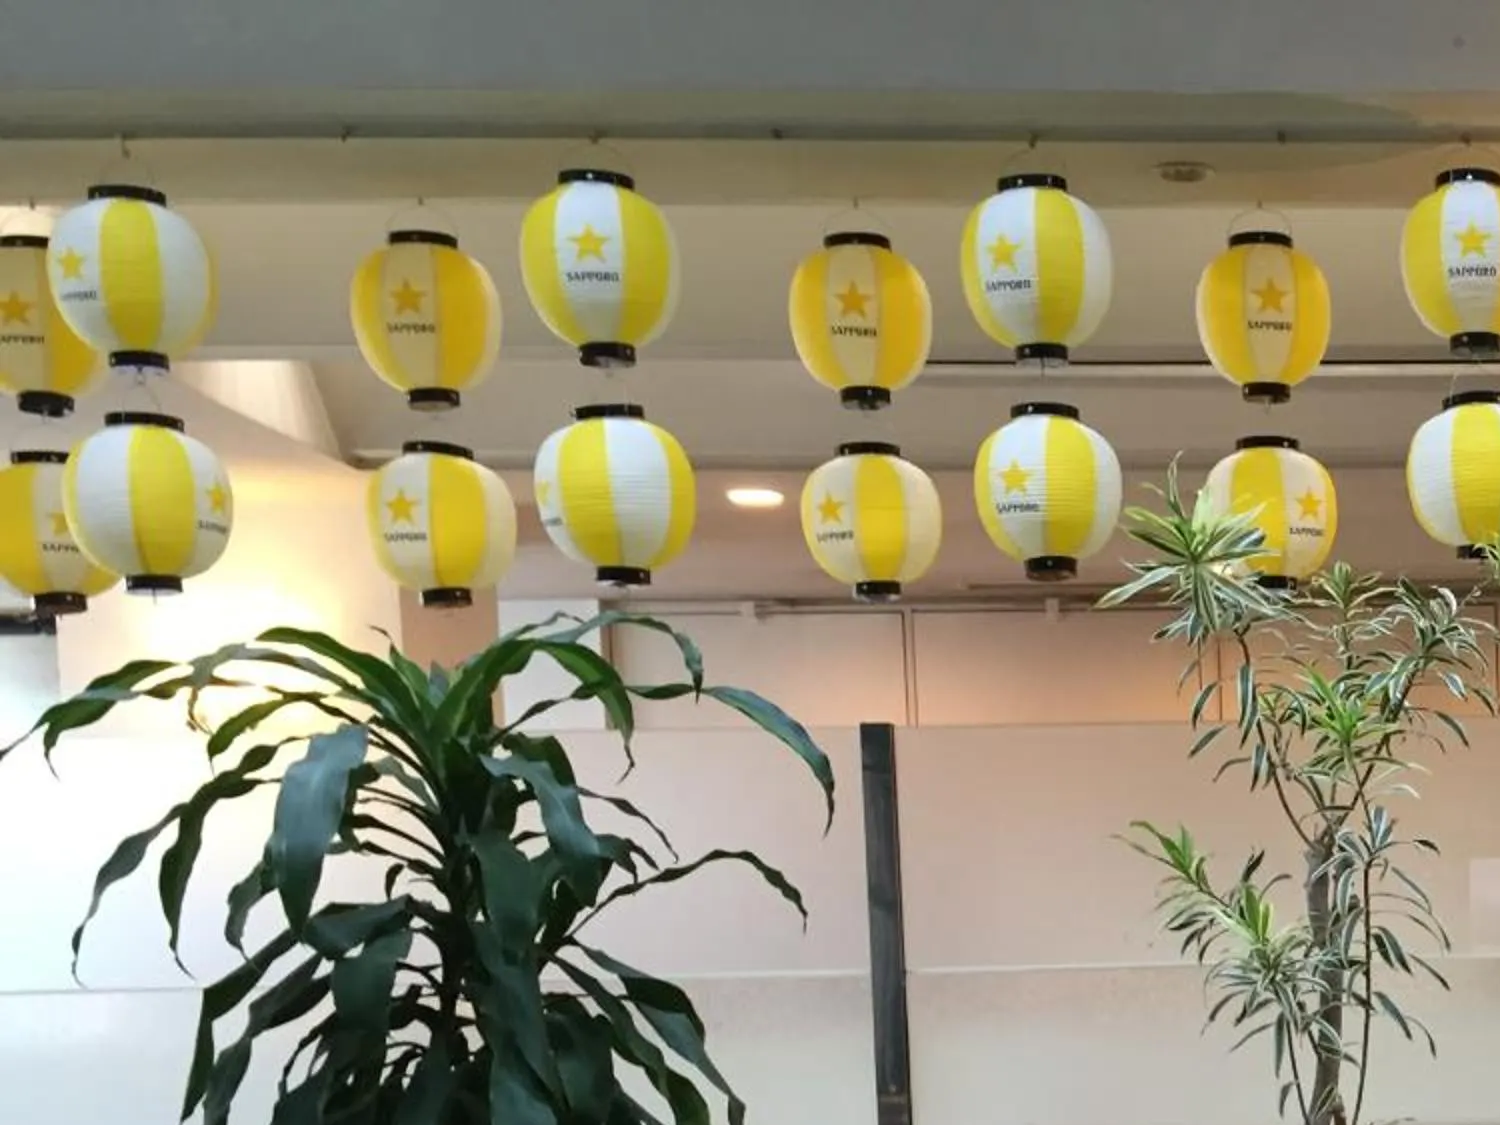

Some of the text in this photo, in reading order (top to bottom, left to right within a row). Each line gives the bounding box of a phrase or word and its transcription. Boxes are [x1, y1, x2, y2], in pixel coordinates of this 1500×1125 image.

[565, 271, 619, 283] SAPPORO
[1448, 265, 1497, 278] SAPPORO
[986, 279, 1031, 292] SAPPORO
[830, 325, 878, 337] SAPPORO
[0, 335, 45, 344] APPORO
